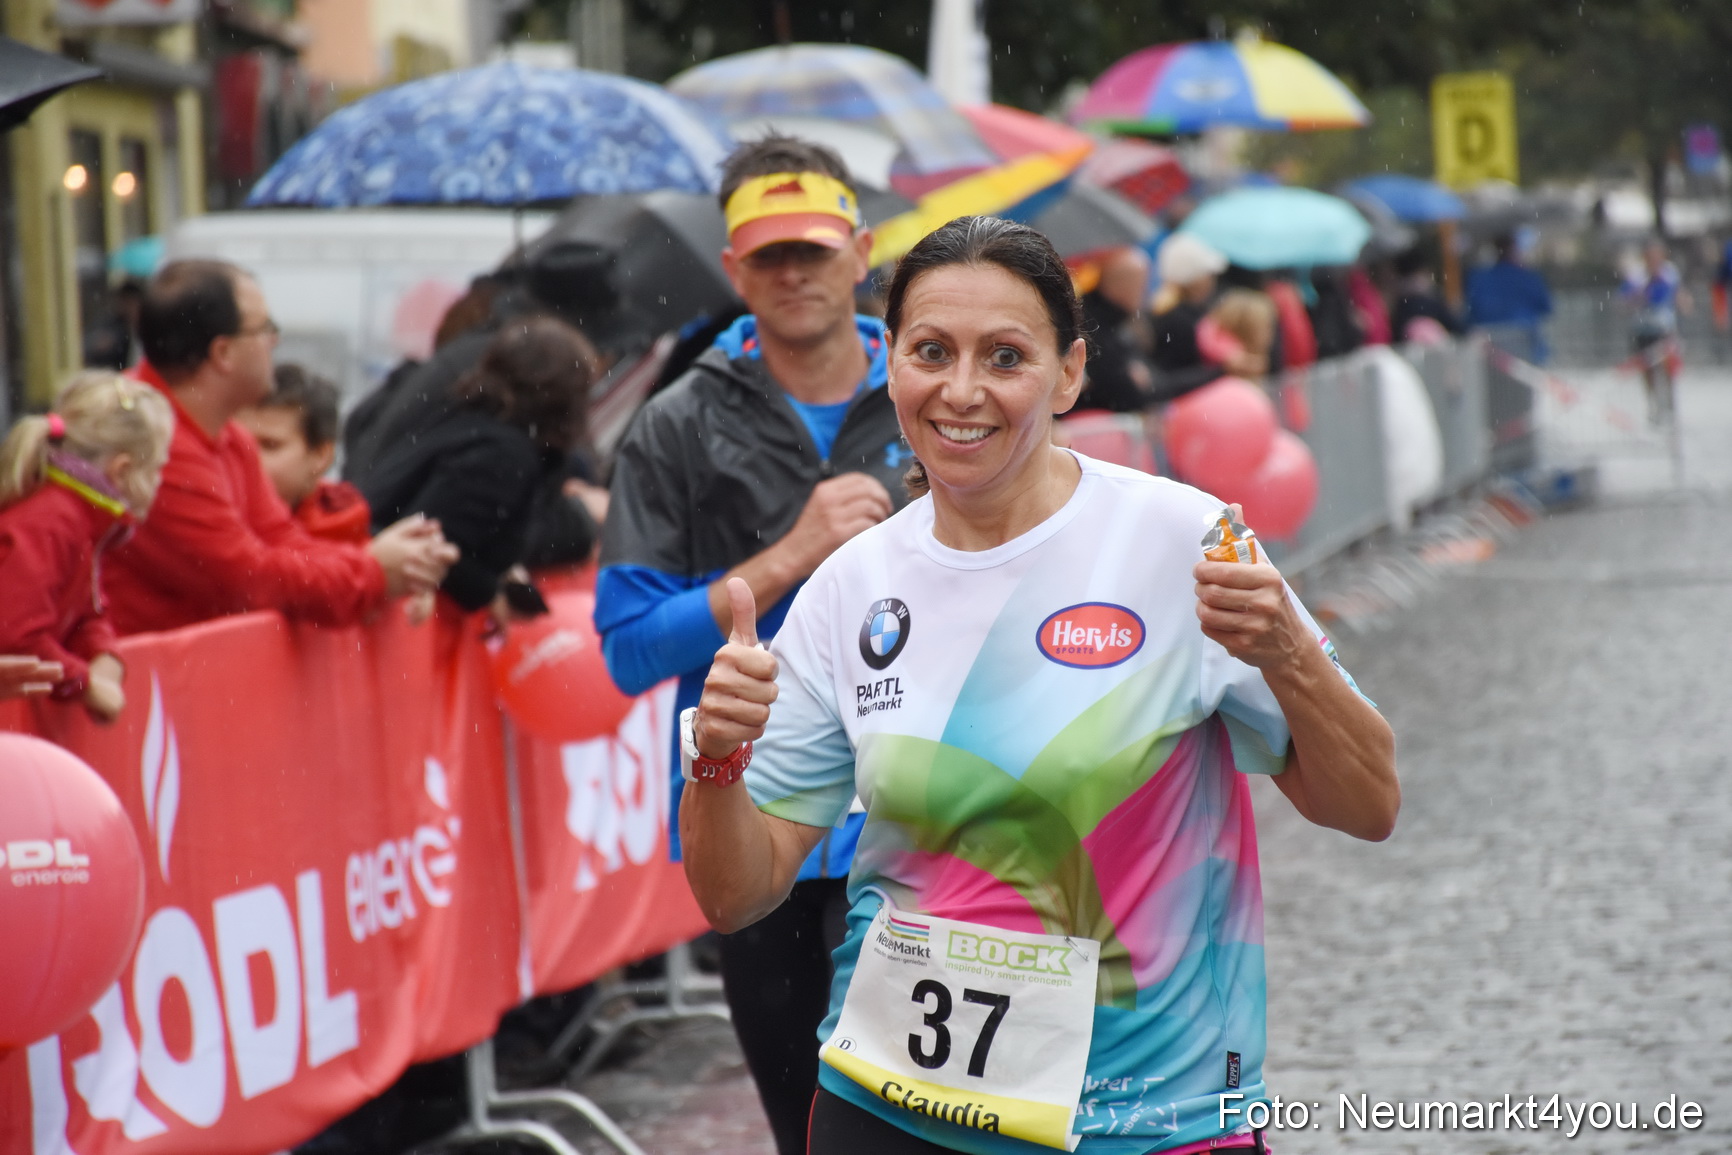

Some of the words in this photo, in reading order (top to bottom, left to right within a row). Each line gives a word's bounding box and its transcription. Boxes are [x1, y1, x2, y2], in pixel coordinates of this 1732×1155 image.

[866, 599, 908, 625] BMW
[1051, 620, 1132, 652] Hervis
[1055, 645, 1095, 655] SPORTS
[856, 677, 904, 704] PARTL
[856, 696, 903, 718] Neumarkt
[0, 837, 91, 871] DL
[946, 930, 1073, 977] BOCK
[944, 960, 983, 976] inspired
[984, 968, 995, 979] by
[997, 971, 1026, 983] smart
[1028, 976, 1073, 988] concepts
[907, 978, 1011, 1079] 37
[838, 1038, 852, 1051] D
[880, 1080, 1001, 1134] Claudia
